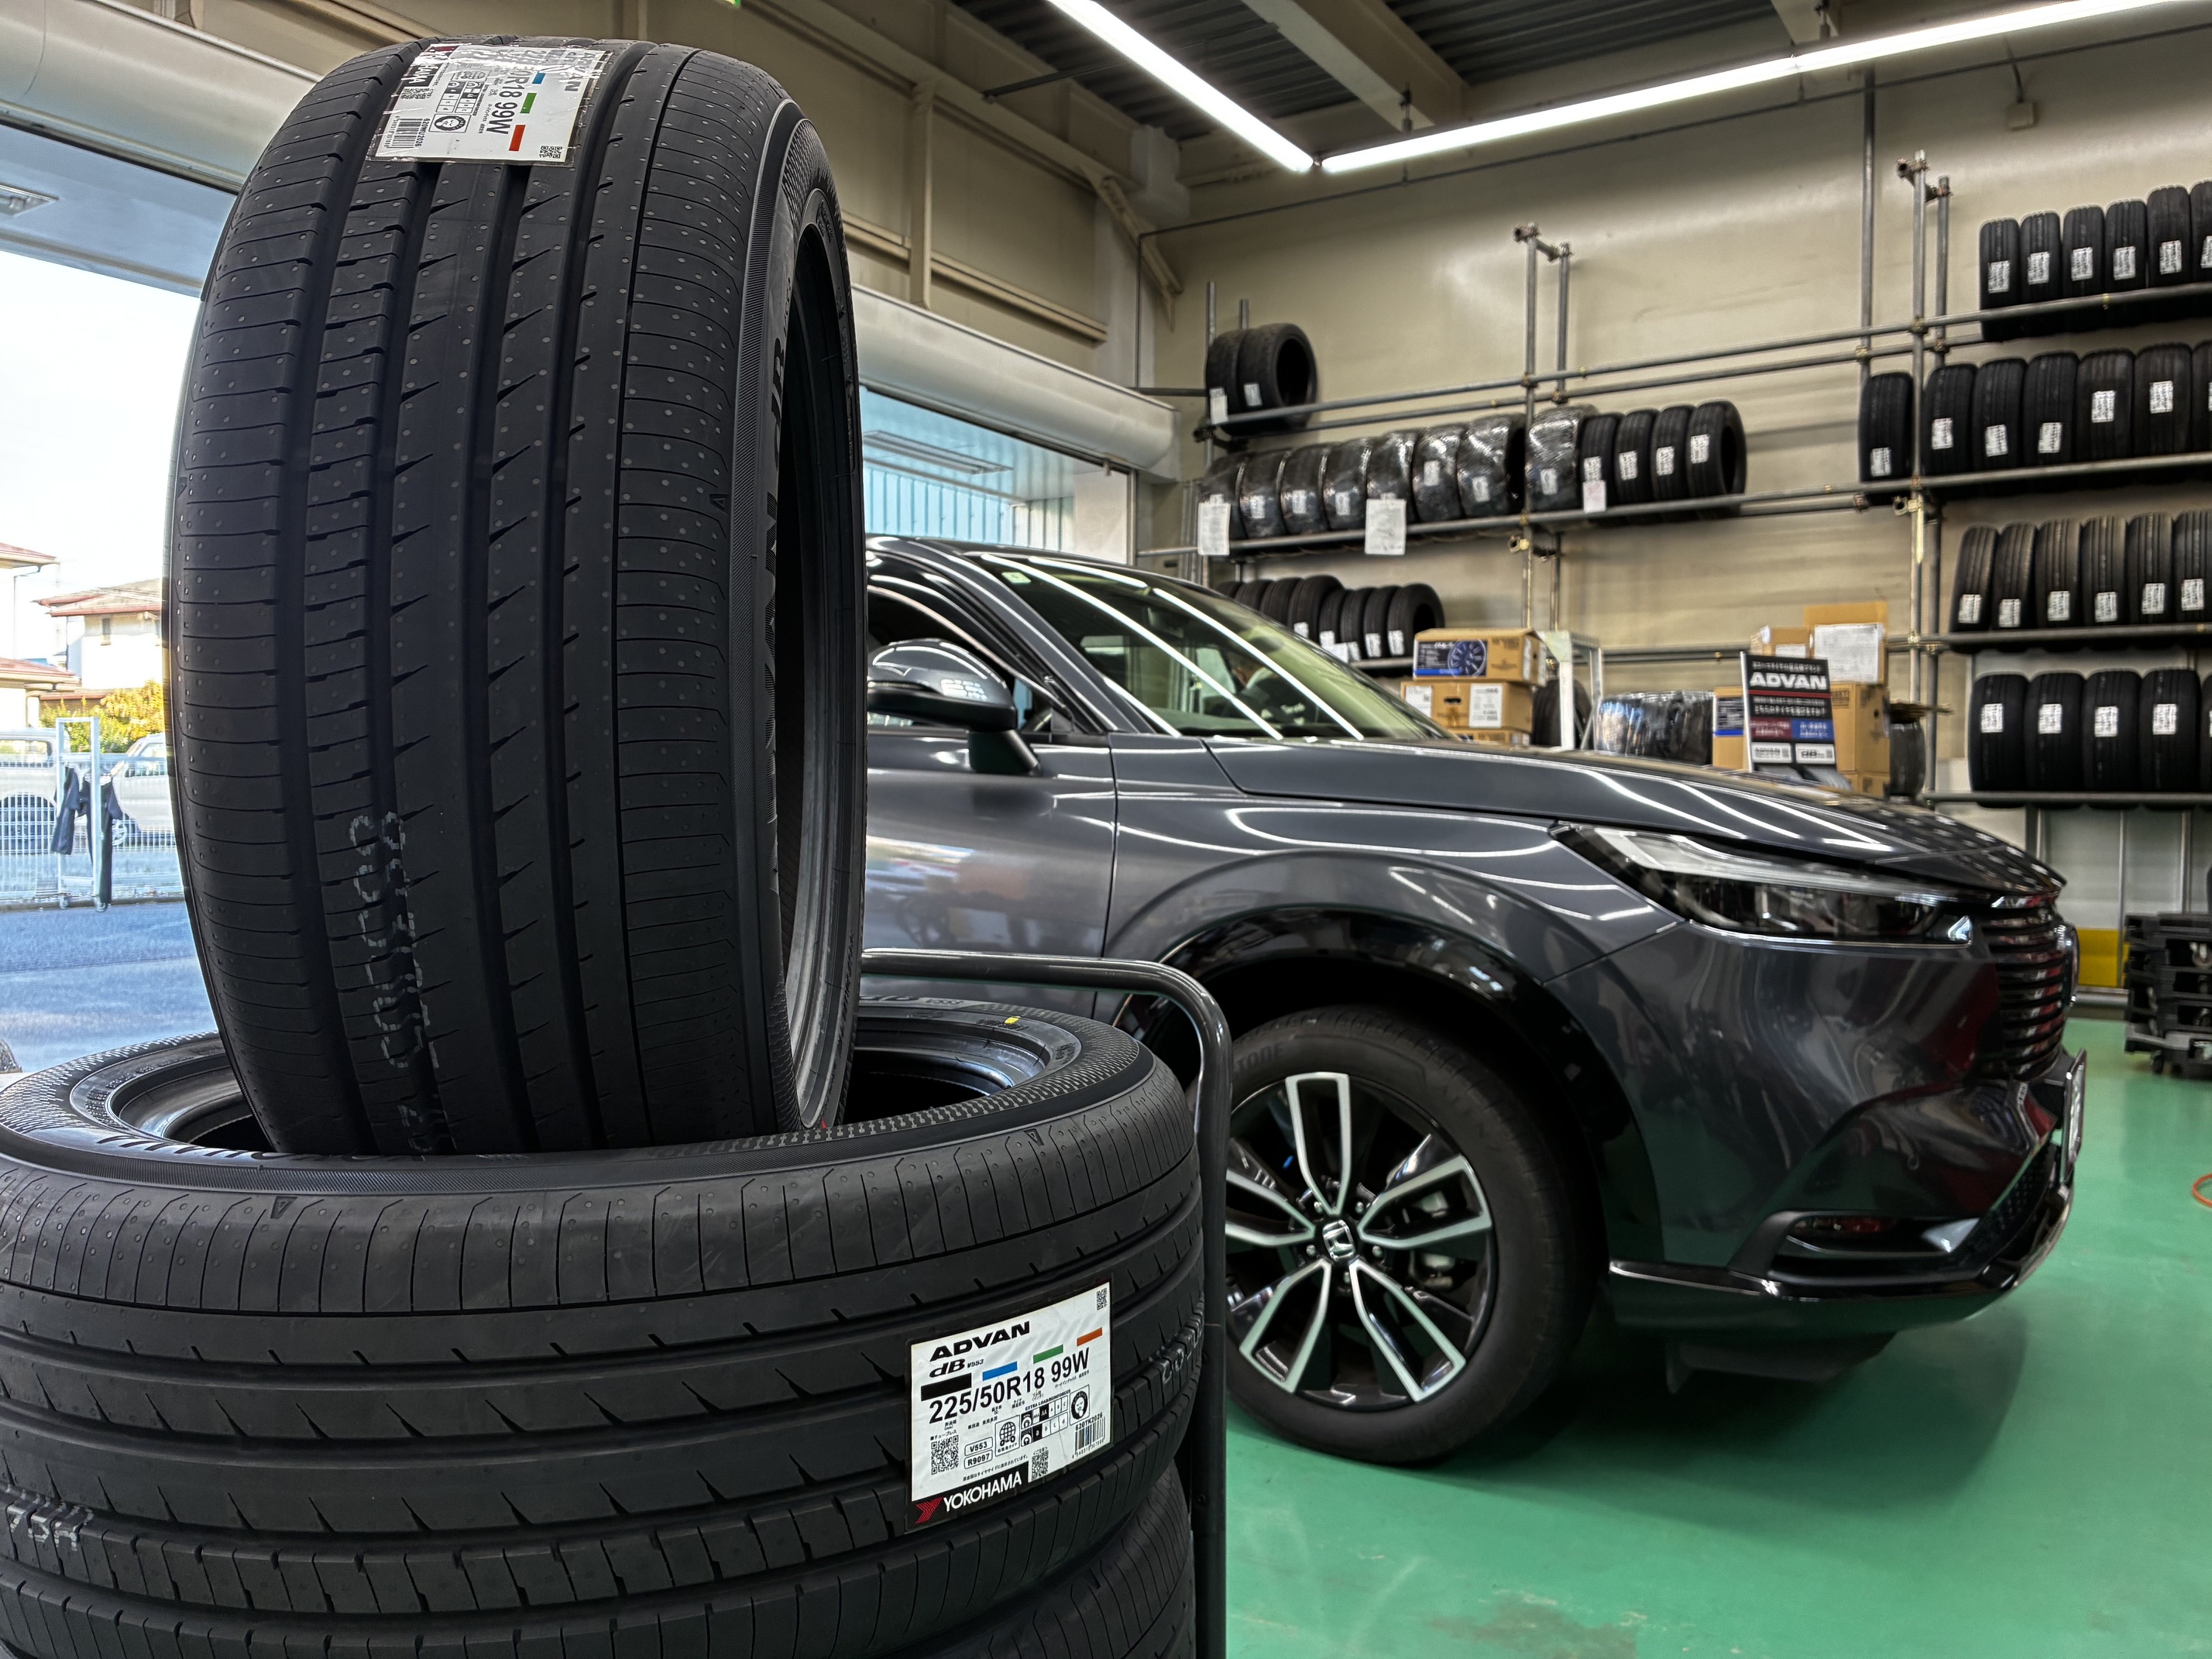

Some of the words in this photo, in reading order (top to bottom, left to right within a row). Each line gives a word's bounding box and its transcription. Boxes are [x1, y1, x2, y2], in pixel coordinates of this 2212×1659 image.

[486, 102, 518, 134] 99W
[1750, 672, 1827, 690] ADVAN
[929, 1321, 1029, 1362] ADVAN
[929, 1358, 965, 1378] dB
[929, 1367, 1045, 1424] 225/50R18
[1051, 1347, 1089, 1382] 99W
[1076, 1412, 1102, 1431] 620TK2026
[970, 1441, 988, 1452] V553
[968, 1453, 990, 1466] R9097
[943, 1471, 1022, 1512] YOKOHAMA
